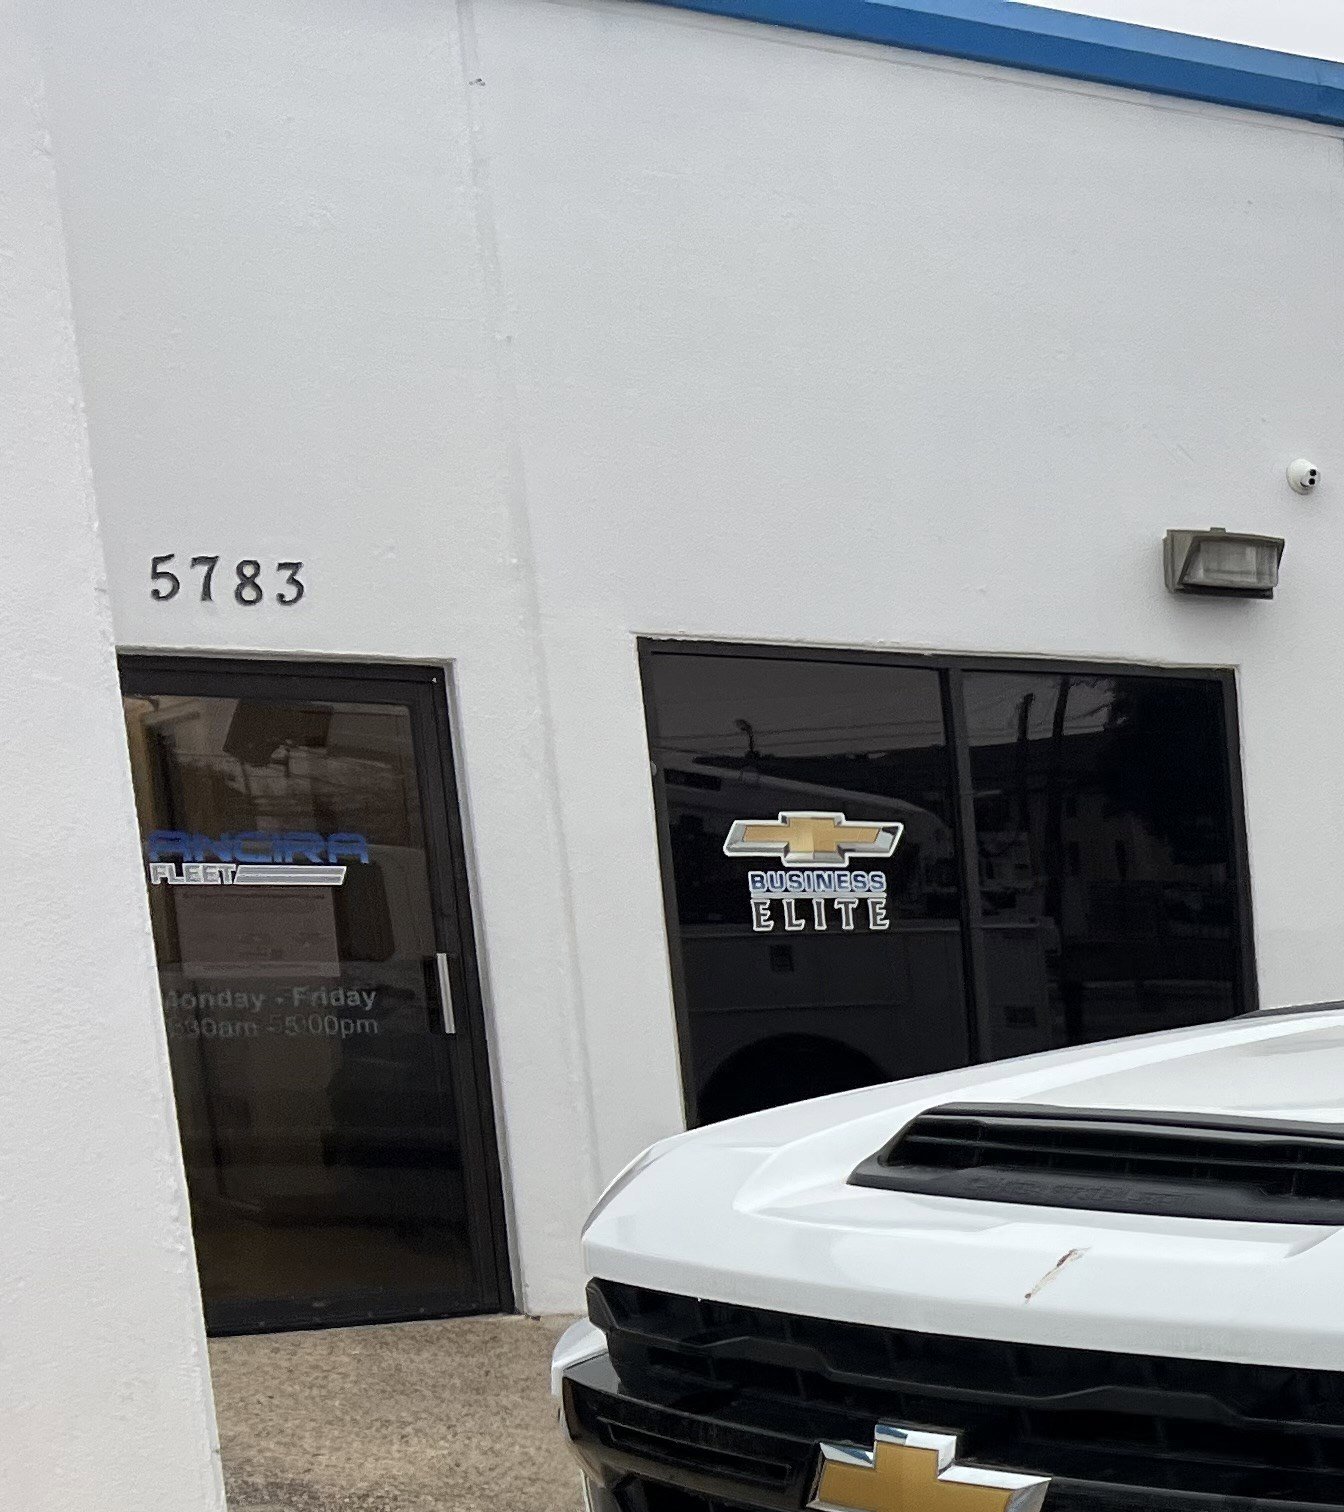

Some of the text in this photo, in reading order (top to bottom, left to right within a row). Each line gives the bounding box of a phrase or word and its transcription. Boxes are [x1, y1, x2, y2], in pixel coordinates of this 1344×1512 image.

[150, 553, 305, 607] 5783
[150, 862, 237, 885] FLEET
[748, 870, 887, 893] BUSINESS
[750, 899, 890, 932] ELITE
[292, 986, 377, 1011] Friday
